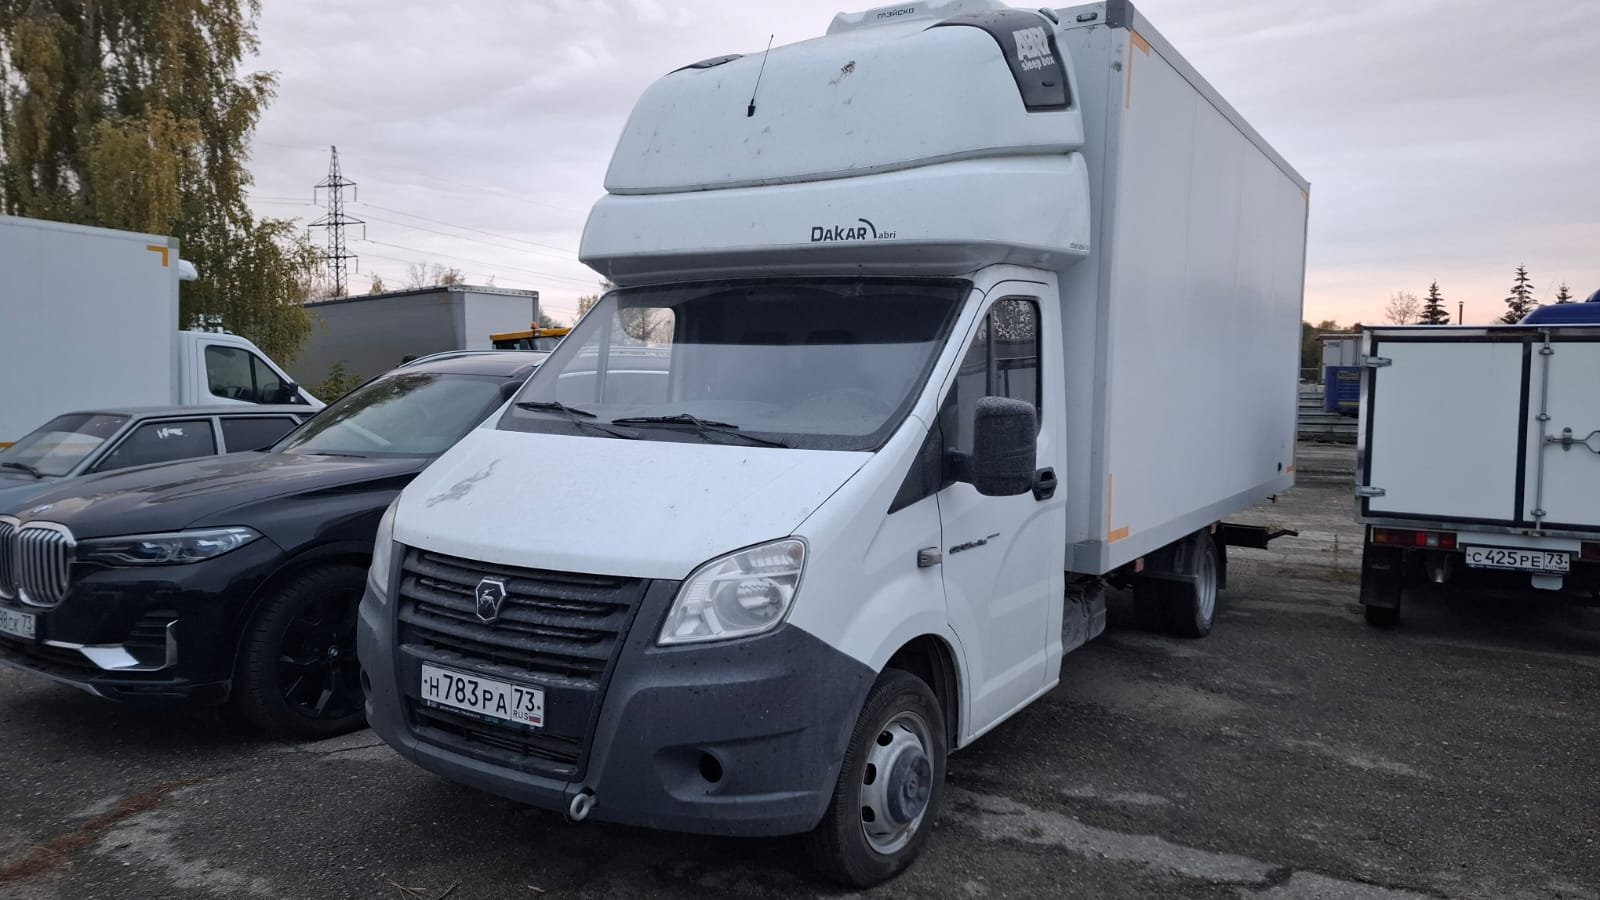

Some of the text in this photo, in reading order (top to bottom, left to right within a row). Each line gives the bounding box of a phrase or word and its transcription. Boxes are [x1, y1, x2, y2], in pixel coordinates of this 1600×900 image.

[1021, 55, 1055, 70] sleep box
[878, 230, 896, 239] abri
[512, 709, 529, 721] RUS
